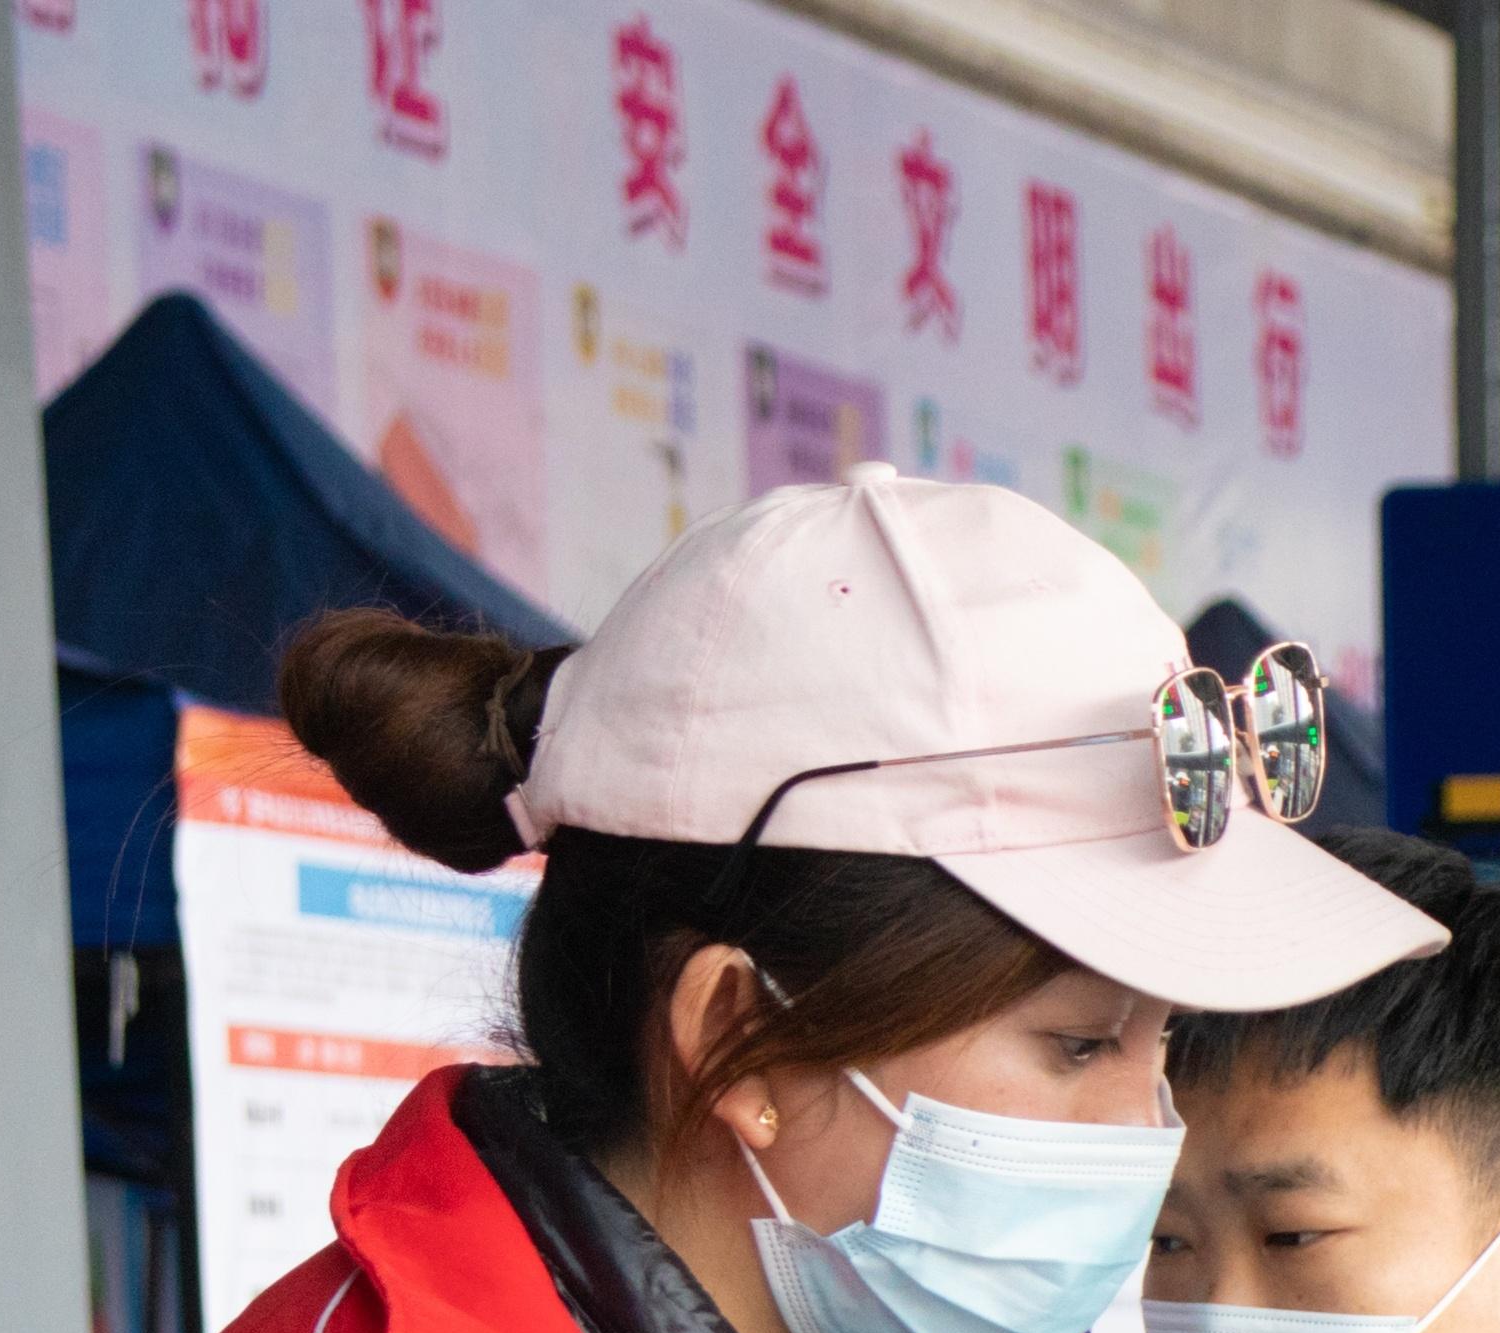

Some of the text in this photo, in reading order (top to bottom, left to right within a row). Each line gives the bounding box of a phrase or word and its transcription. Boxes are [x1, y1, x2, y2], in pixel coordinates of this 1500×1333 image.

[610, 12, 1307, 458] 安全文明出行
